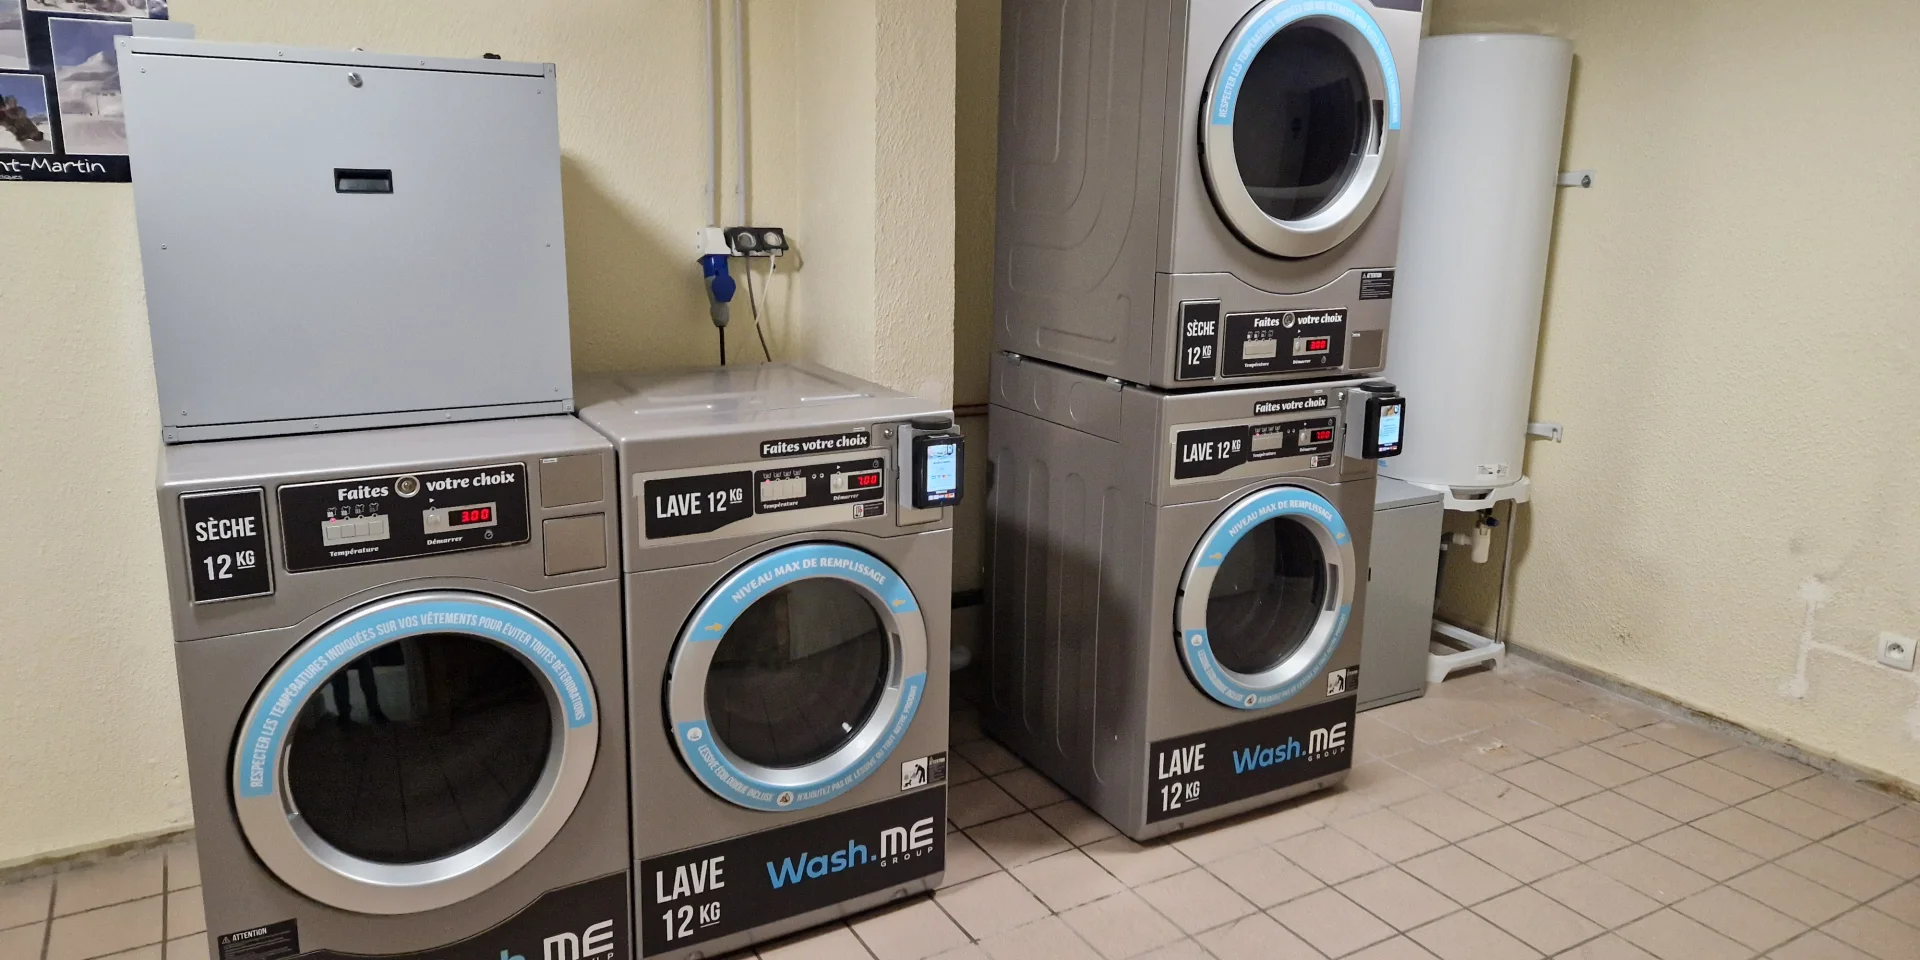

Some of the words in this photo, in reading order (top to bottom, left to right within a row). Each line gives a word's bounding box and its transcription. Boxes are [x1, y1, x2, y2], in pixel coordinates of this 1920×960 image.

[1230, 61, 1243, 77] LES
[1187, 319, 1215, 337] SÈCHE
[1254, 317, 1280, 328] Faites
[1297, 315, 1320, 325] votre
[1321, 312, 1343, 323] choix
[1187, 346, 1201, 366] 12
[1202, 345, 1212, 358] KG
[1255, 402, 1280, 413] Faites
[1281, 399, 1303, 411] votre
[1304, 396, 1326, 408] choix
[763, 441, 801, 455] Faites
[802, 438, 834, 451] votre
[836, 434, 868, 448] choix
[1183, 442, 1214, 463] LAVE
[1217, 440, 1230, 460] 12
[1232, 439, 1241, 453] KG
[338, 485, 389, 501] Faites
[426, 476, 470, 492] votre
[473, 471, 515, 486] choix
[656, 492, 702, 519] LAVE
[707, 490, 727, 513] 12
[729, 487, 743, 504] KG
[195, 515, 257, 543] SÈCHE
[1228, 511, 1258, 538] NIVEAU
[1258, 503, 1277, 517] MAX
[1278, 499, 1288, 509] DE
[1290, 499, 1334, 522] REMPLISSAGE
[426, 535, 463, 546] Démarrer
[329, 546, 380, 558] Température
[203, 554, 234, 582] 12
[236, 549, 256, 568] KG
[731, 571, 773, 604] NIVEAU
[774, 561, 800, 577] MAX
[802, 557, 818, 570] DE
[819, 557, 887, 585] REMPLISSAGE
[376, 621, 397, 636] SUR
[399, 615, 418, 630] VOS
[420, 611, 478, 626] VÊTEMENTS
[478, 616, 503, 632] POUR
[325, 627, 377, 661] INDIQUÉES
[502, 622, 532, 645] ÉVITER
[529, 637, 557, 664] TOUTES
[270, 656, 329, 719] TEMPÉRATURES
[263, 718, 278, 736] LES
[250, 735, 272, 788] RESPECTER
[1158, 743, 1207, 780] LAVE
[1307, 746, 1346, 762] GROUP
[1160, 782, 1183, 812] 12
[1185, 780, 1201, 803] KG
[880, 846, 934, 868] GROUP
[656, 855, 726, 904] LAVE
[662, 904, 695, 942] 12
[699, 901, 722, 928] KG
[232, 926, 268, 942] ATTENTION
